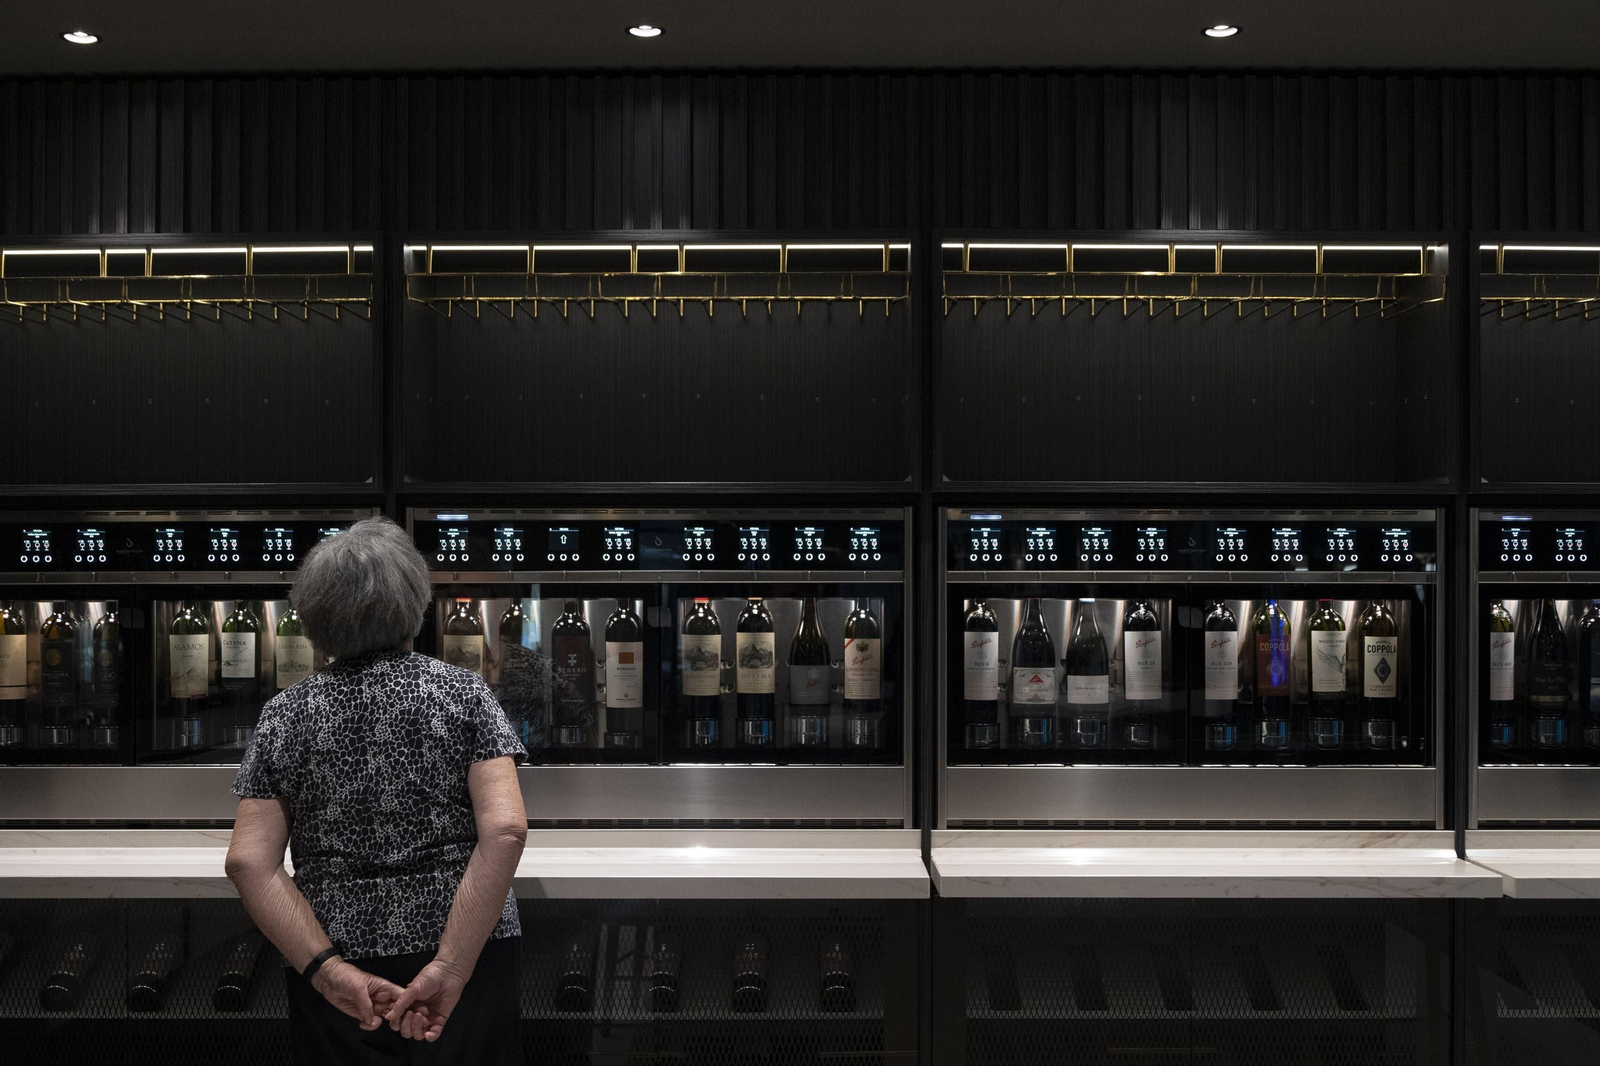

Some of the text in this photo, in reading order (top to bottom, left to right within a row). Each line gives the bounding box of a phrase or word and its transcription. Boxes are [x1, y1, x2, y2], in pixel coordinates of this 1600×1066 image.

[173, 643, 204, 651] ALAMOS
[1259, 642, 1289, 652] COPPOLA
[1367, 644, 1396, 654] COPPOLA
